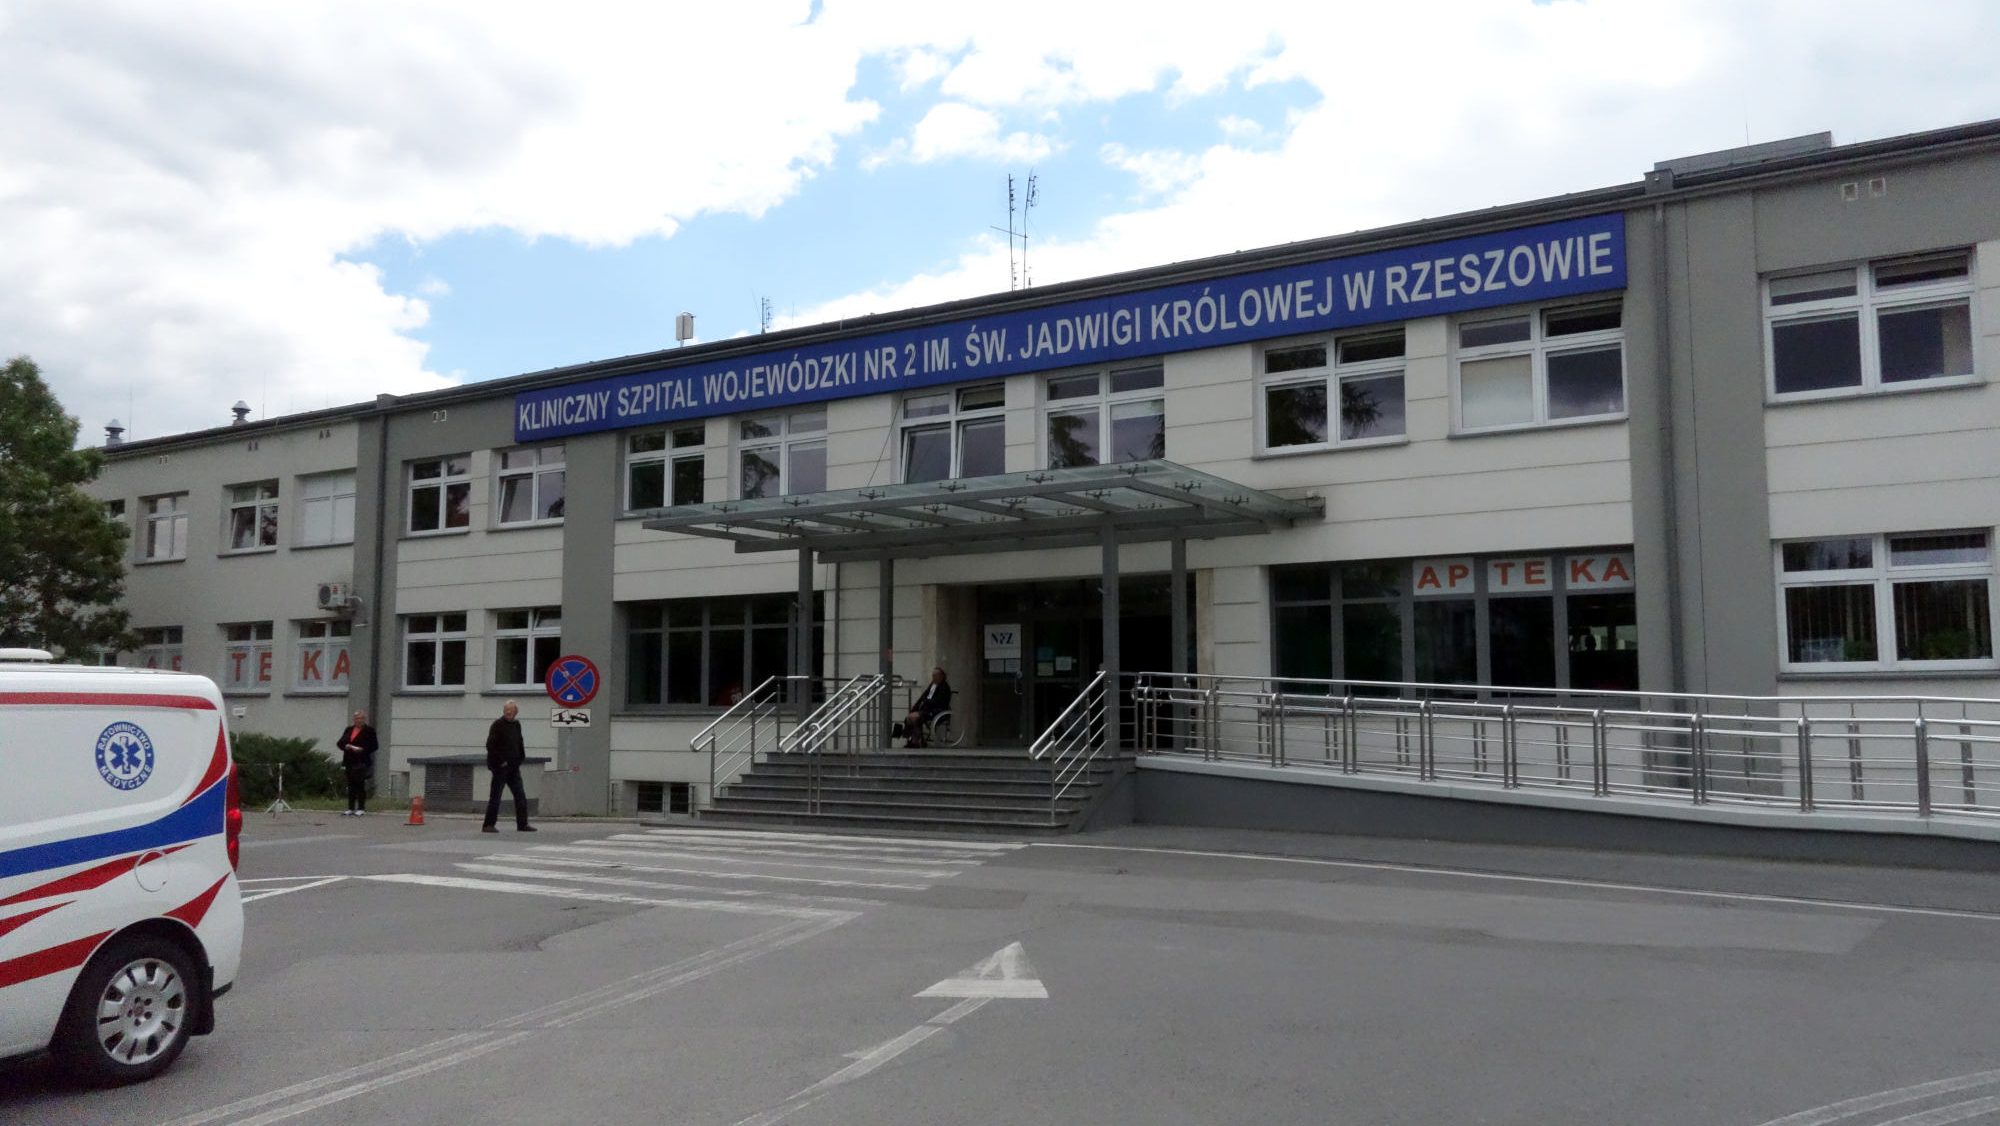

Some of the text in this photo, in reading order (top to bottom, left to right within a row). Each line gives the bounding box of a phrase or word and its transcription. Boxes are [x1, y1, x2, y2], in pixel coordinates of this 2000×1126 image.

[519, 232, 1613, 431] KLINICZNY SZPITAL WOJEWÓDZKI NR 2 IM. ŚW. JADWIGI KRÓLOWEJ W RZESZOWIE
[1417, 557, 1630, 589] APTEKA
[98, 723, 151, 751] RATOWNICTWO
[100, 764, 152, 789] MEDYCZNE
